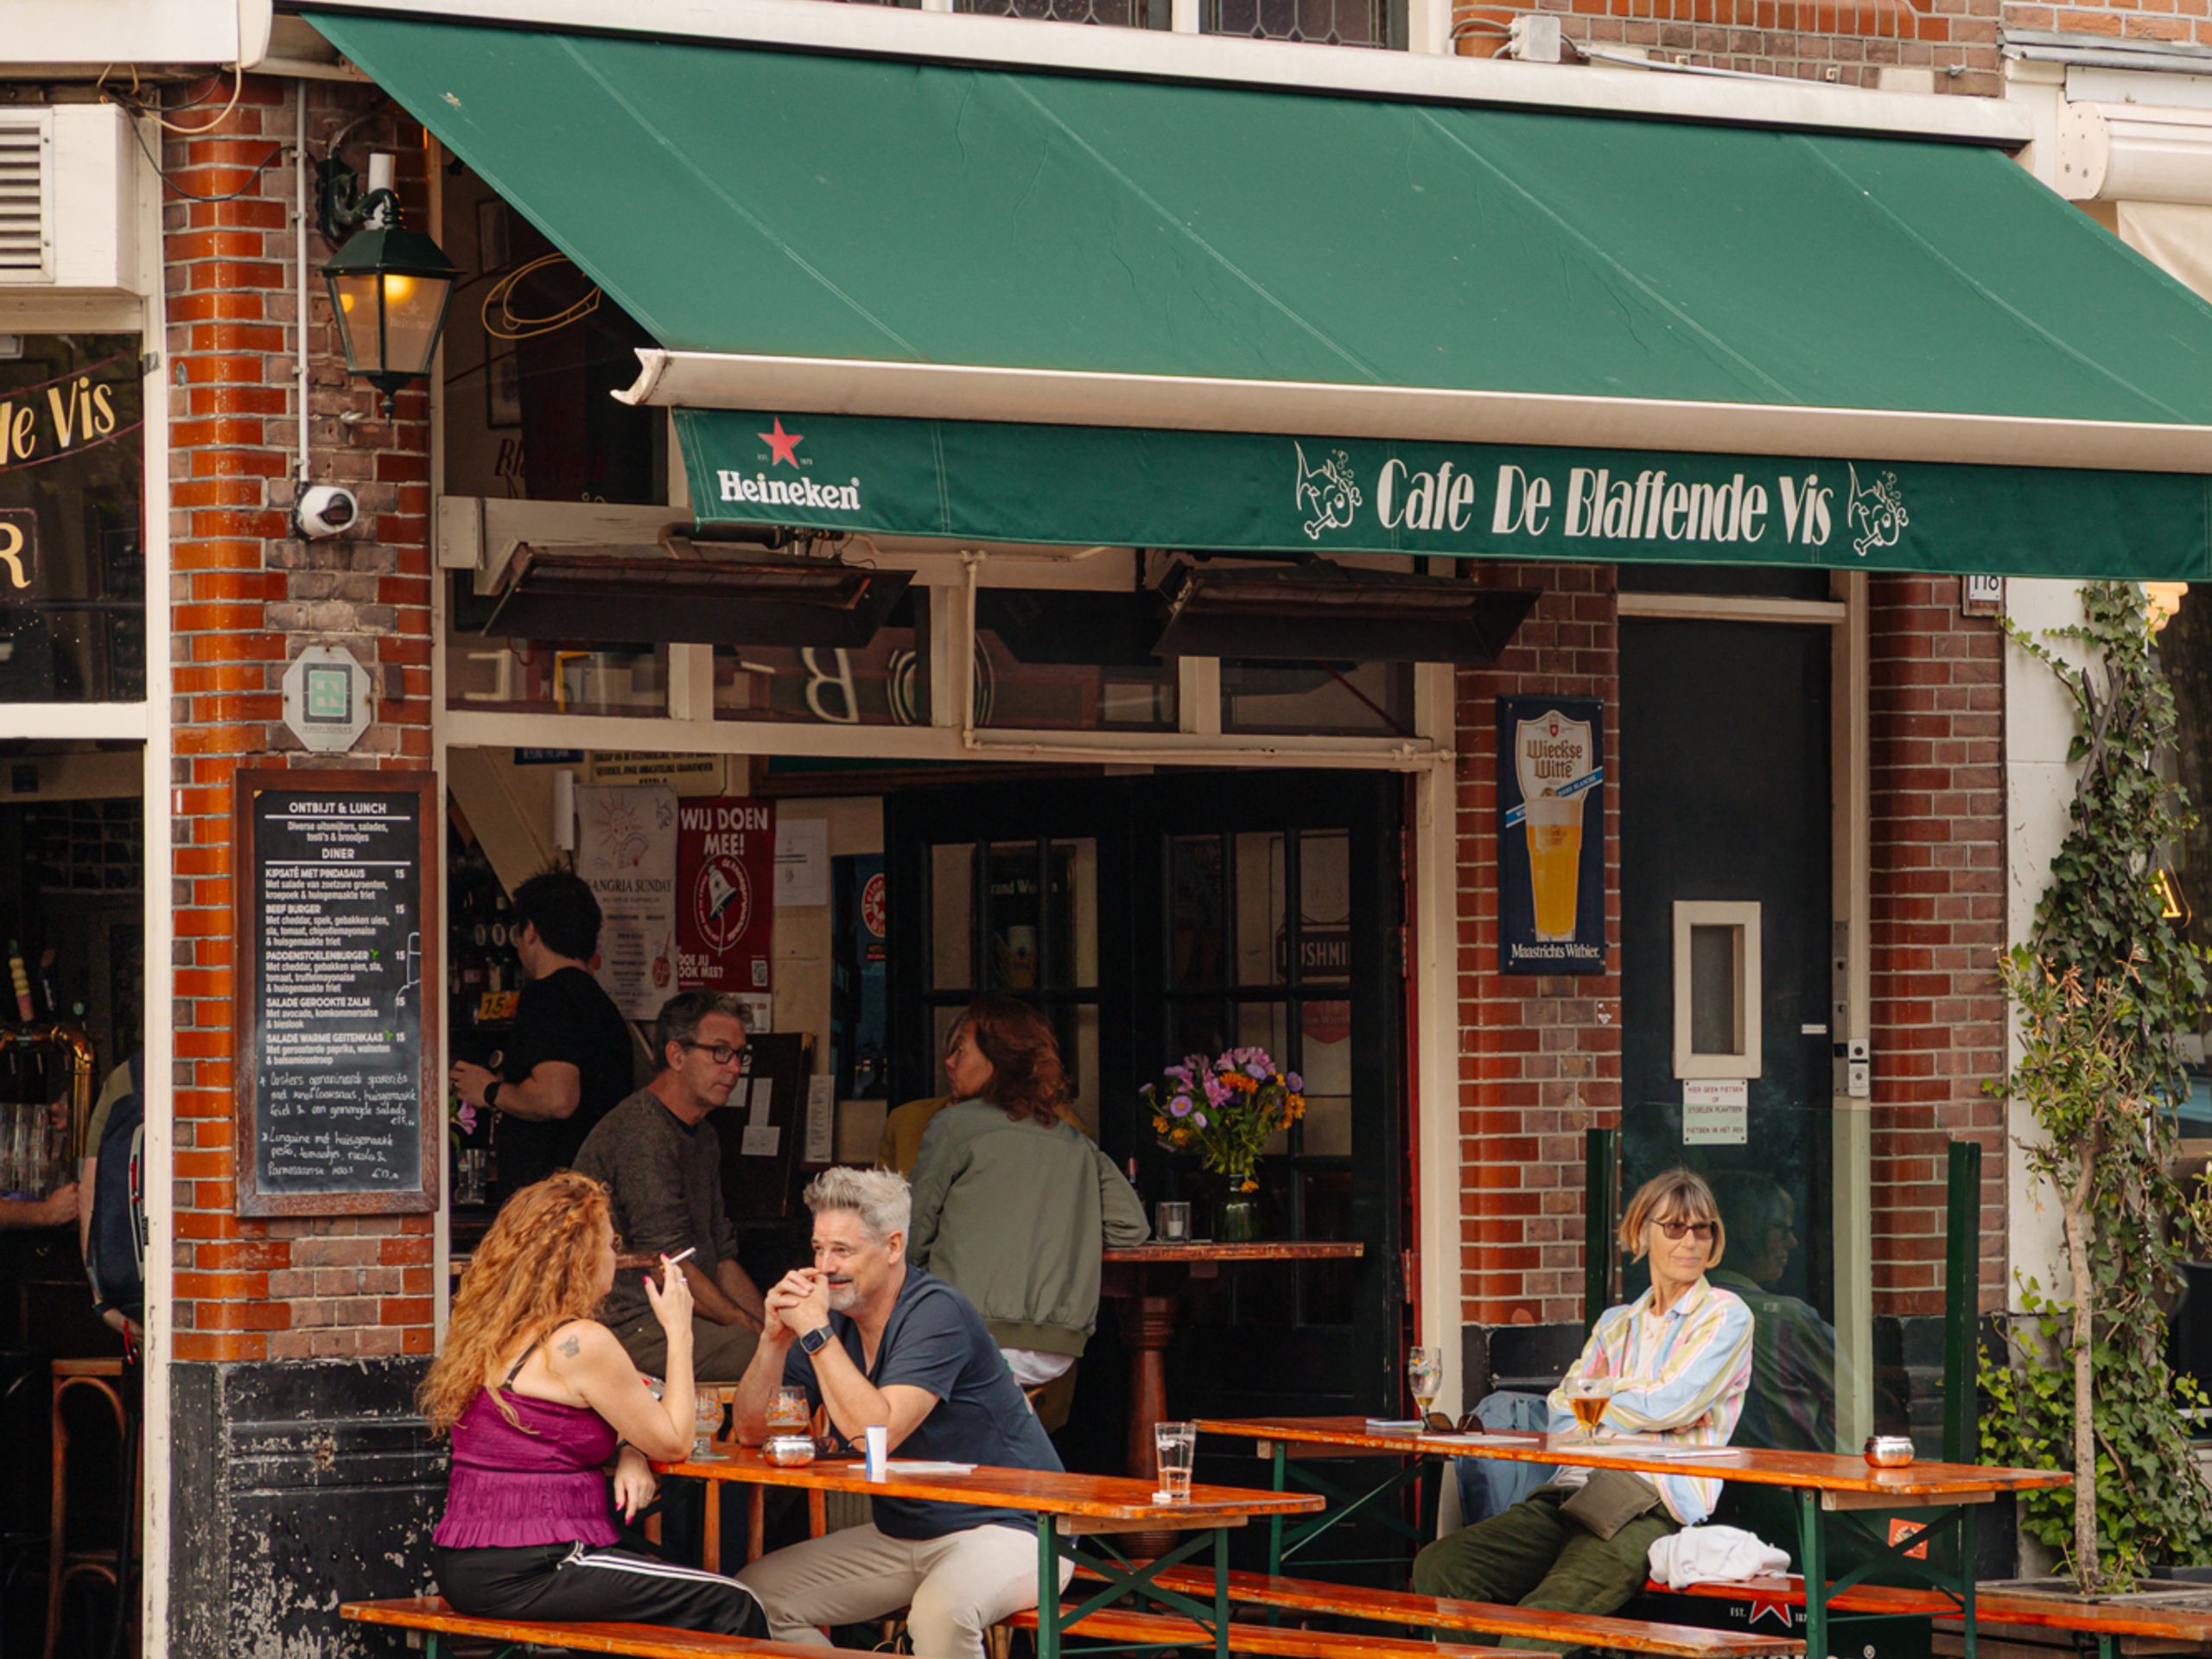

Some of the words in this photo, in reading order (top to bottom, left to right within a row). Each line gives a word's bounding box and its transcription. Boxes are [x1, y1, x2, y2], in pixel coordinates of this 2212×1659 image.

[48, 376, 116, 448] Vis
[716, 470, 861, 510] Heineken
[1377, 459, 1474, 531] Cafe
[1492, 465, 1551, 537] De
[1564, 467, 1768, 542] Blaffende
[1779, 474, 1834, 545] Vis
[1527, 740, 1583, 759] Wieckse
[1534, 760, 1574, 779] Witte
[289, 802, 335, 814] ONTBIJT
[349, 802, 387, 814] LUNCH
[681, 808, 711, 830] WIJ
[717, 807, 768, 830] DOEN
[703, 834, 745, 855] MEE!
[321, 848, 355, 859] DINER
[265, 866, 300, 878] KIPSATÉ
[301, 868, 317, 878] MET
[319, 868, 365, 878] PINDASAUS
[395, 868, 405, 878] 15
[265, 905, 286, 914] BEEF
[288, 905, 321, 914] BURGER
[395, 905, 405, 914] 15
[265, 950, 369, 960] PADDENSTOELENBURGER
[395, 950, 405, 960] 15
[1511, 944, 1565, 958] Maastrichts
[265, 997, 297, 1007] SALADE
[300, 997, 345, 1007] GEROOKTE
[347, 997, 371, 1007] ZALM
[395, 997, 405, 1007] 15
[265, 1033, 297, 1042] SALADE
[333, 1033, 384, 1042] GEITENKAAS
[396, 1033, 405, 1042] 15
[1730, 1607, 1747, 1618] EST.
